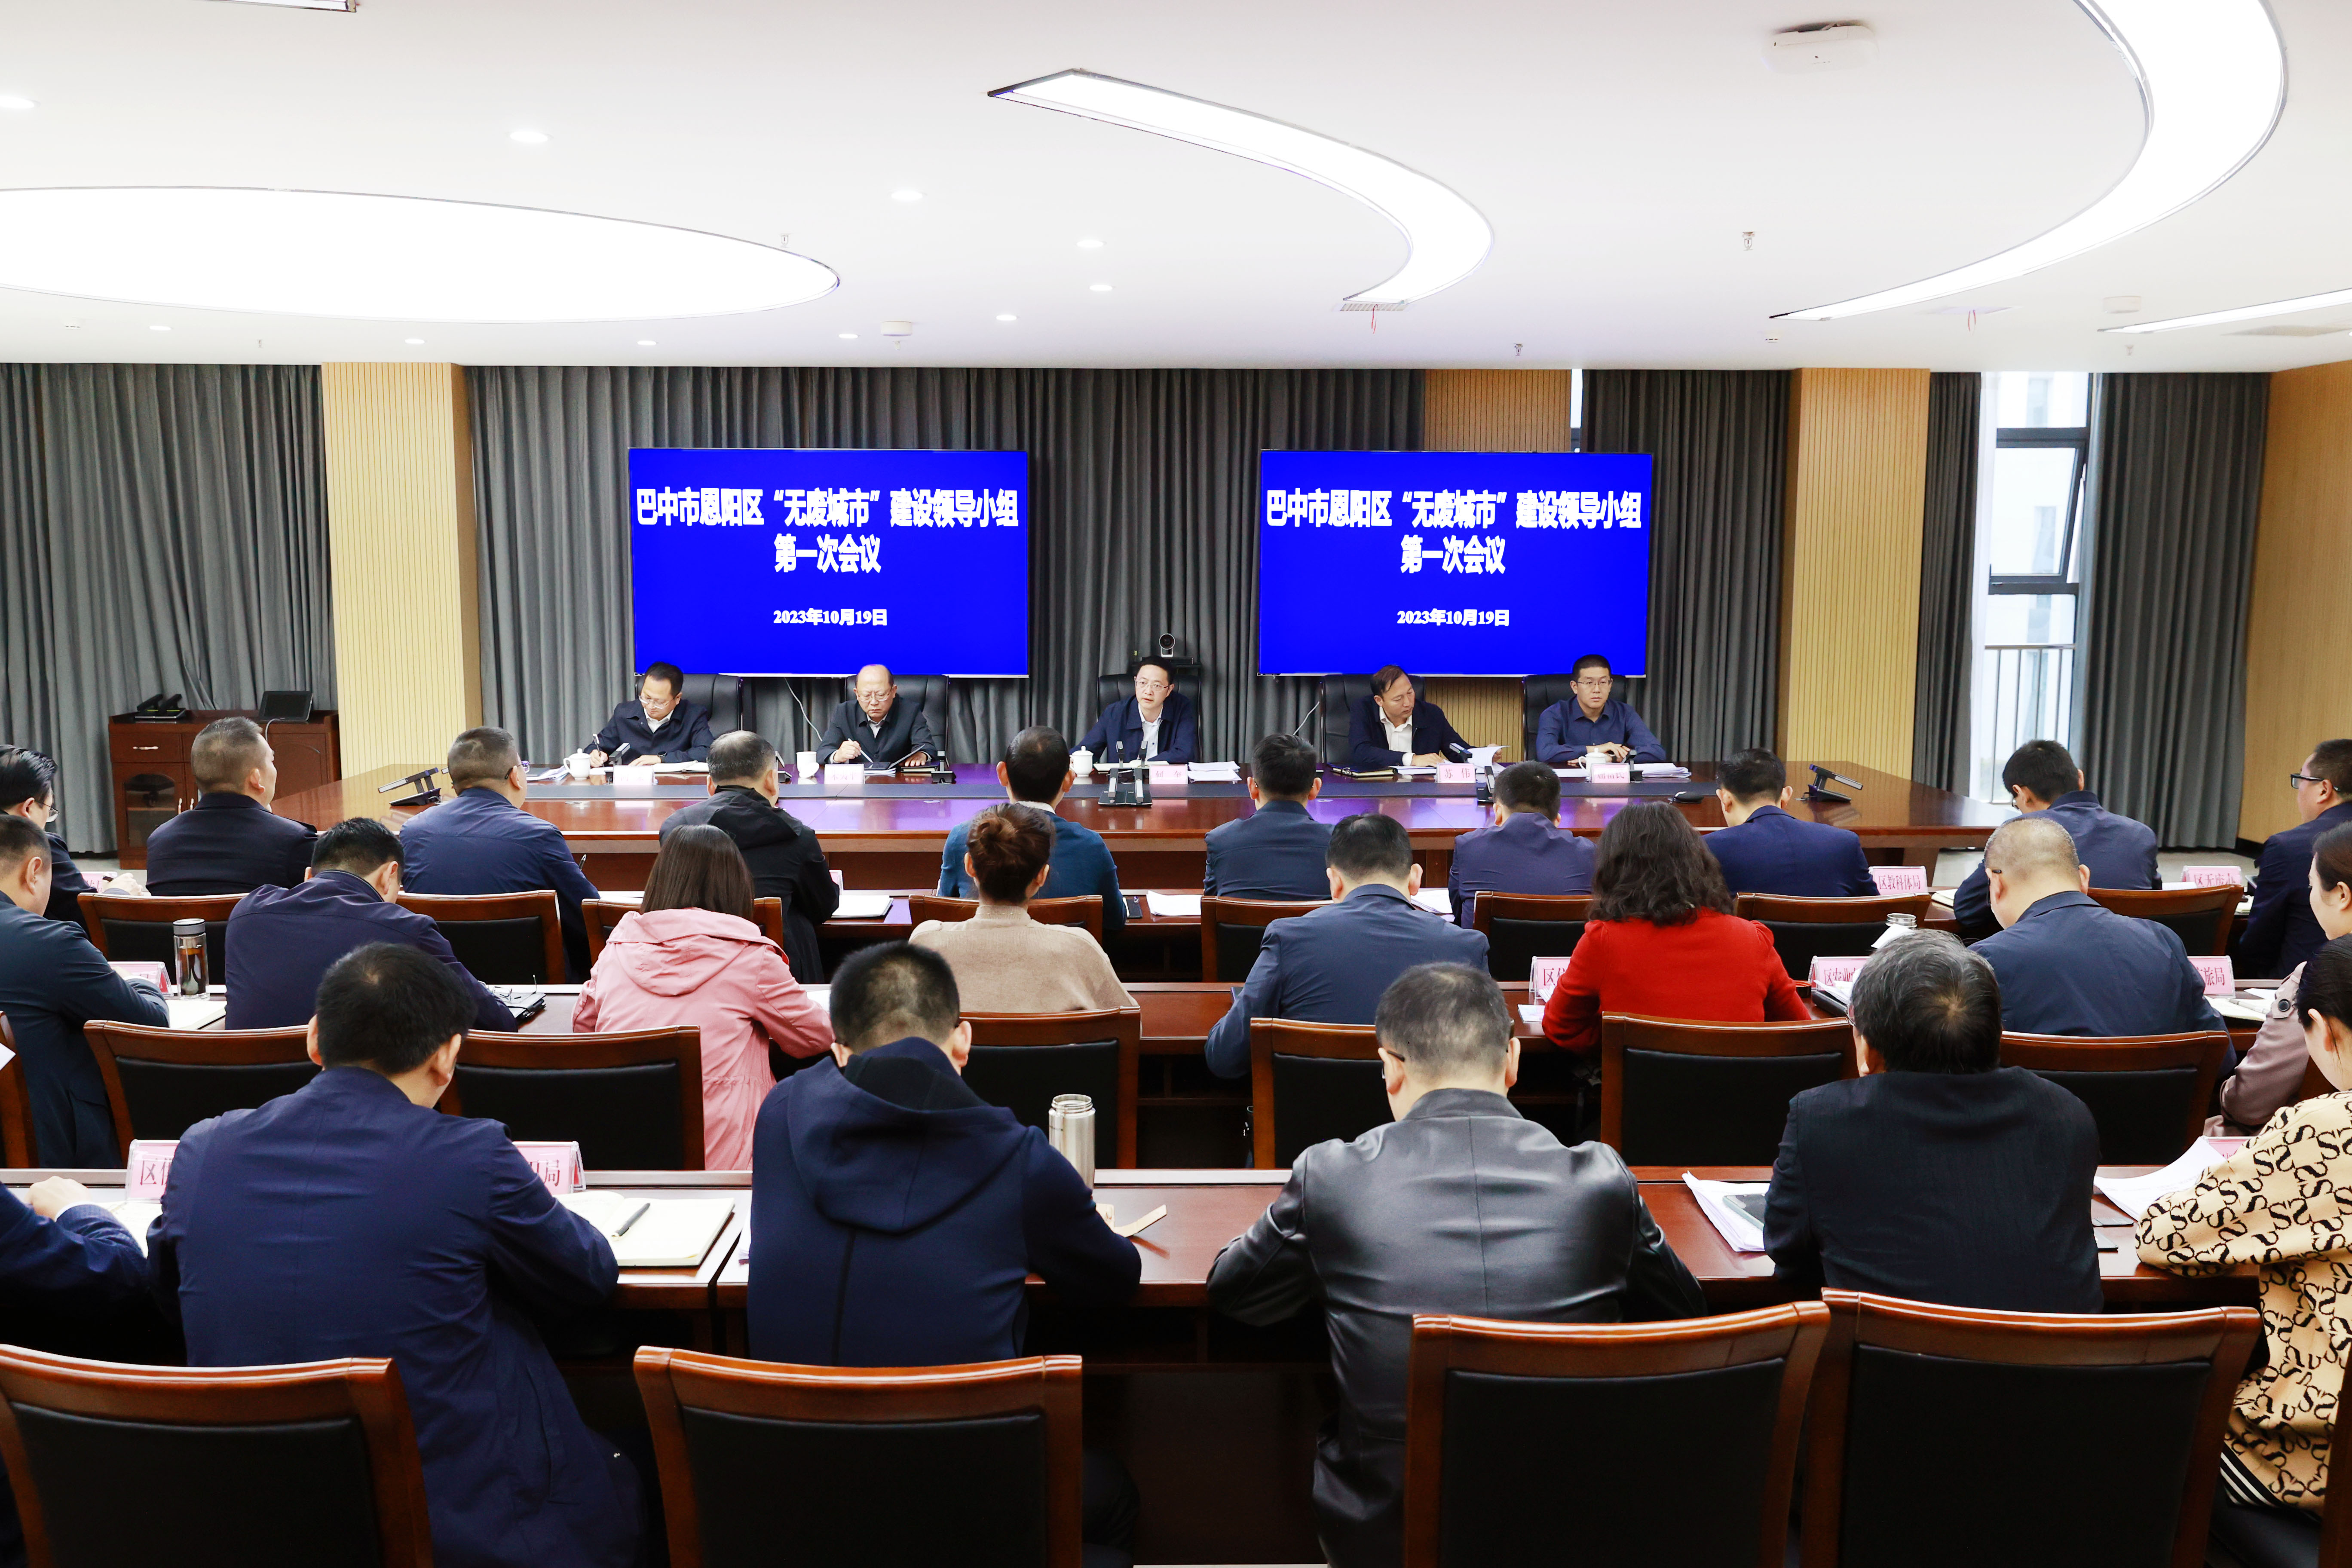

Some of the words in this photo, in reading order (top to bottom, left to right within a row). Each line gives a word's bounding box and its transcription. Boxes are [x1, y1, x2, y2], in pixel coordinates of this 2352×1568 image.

[774, 533, 882, 574] 第一次会议
[1400, 534, 1506, 575] 第一次会议
[773, 607, 887, 626] 2023年10月19日
[1396, 608, 1510, 626] 2023年10月19日
[1445, 768, 1470, 779] 苏伟
[1878, 874, 1921, 890] 区教科体局
[1824, 968, 1856, 986] 区农业
[2196, 967, 2226, 986] 旅局
